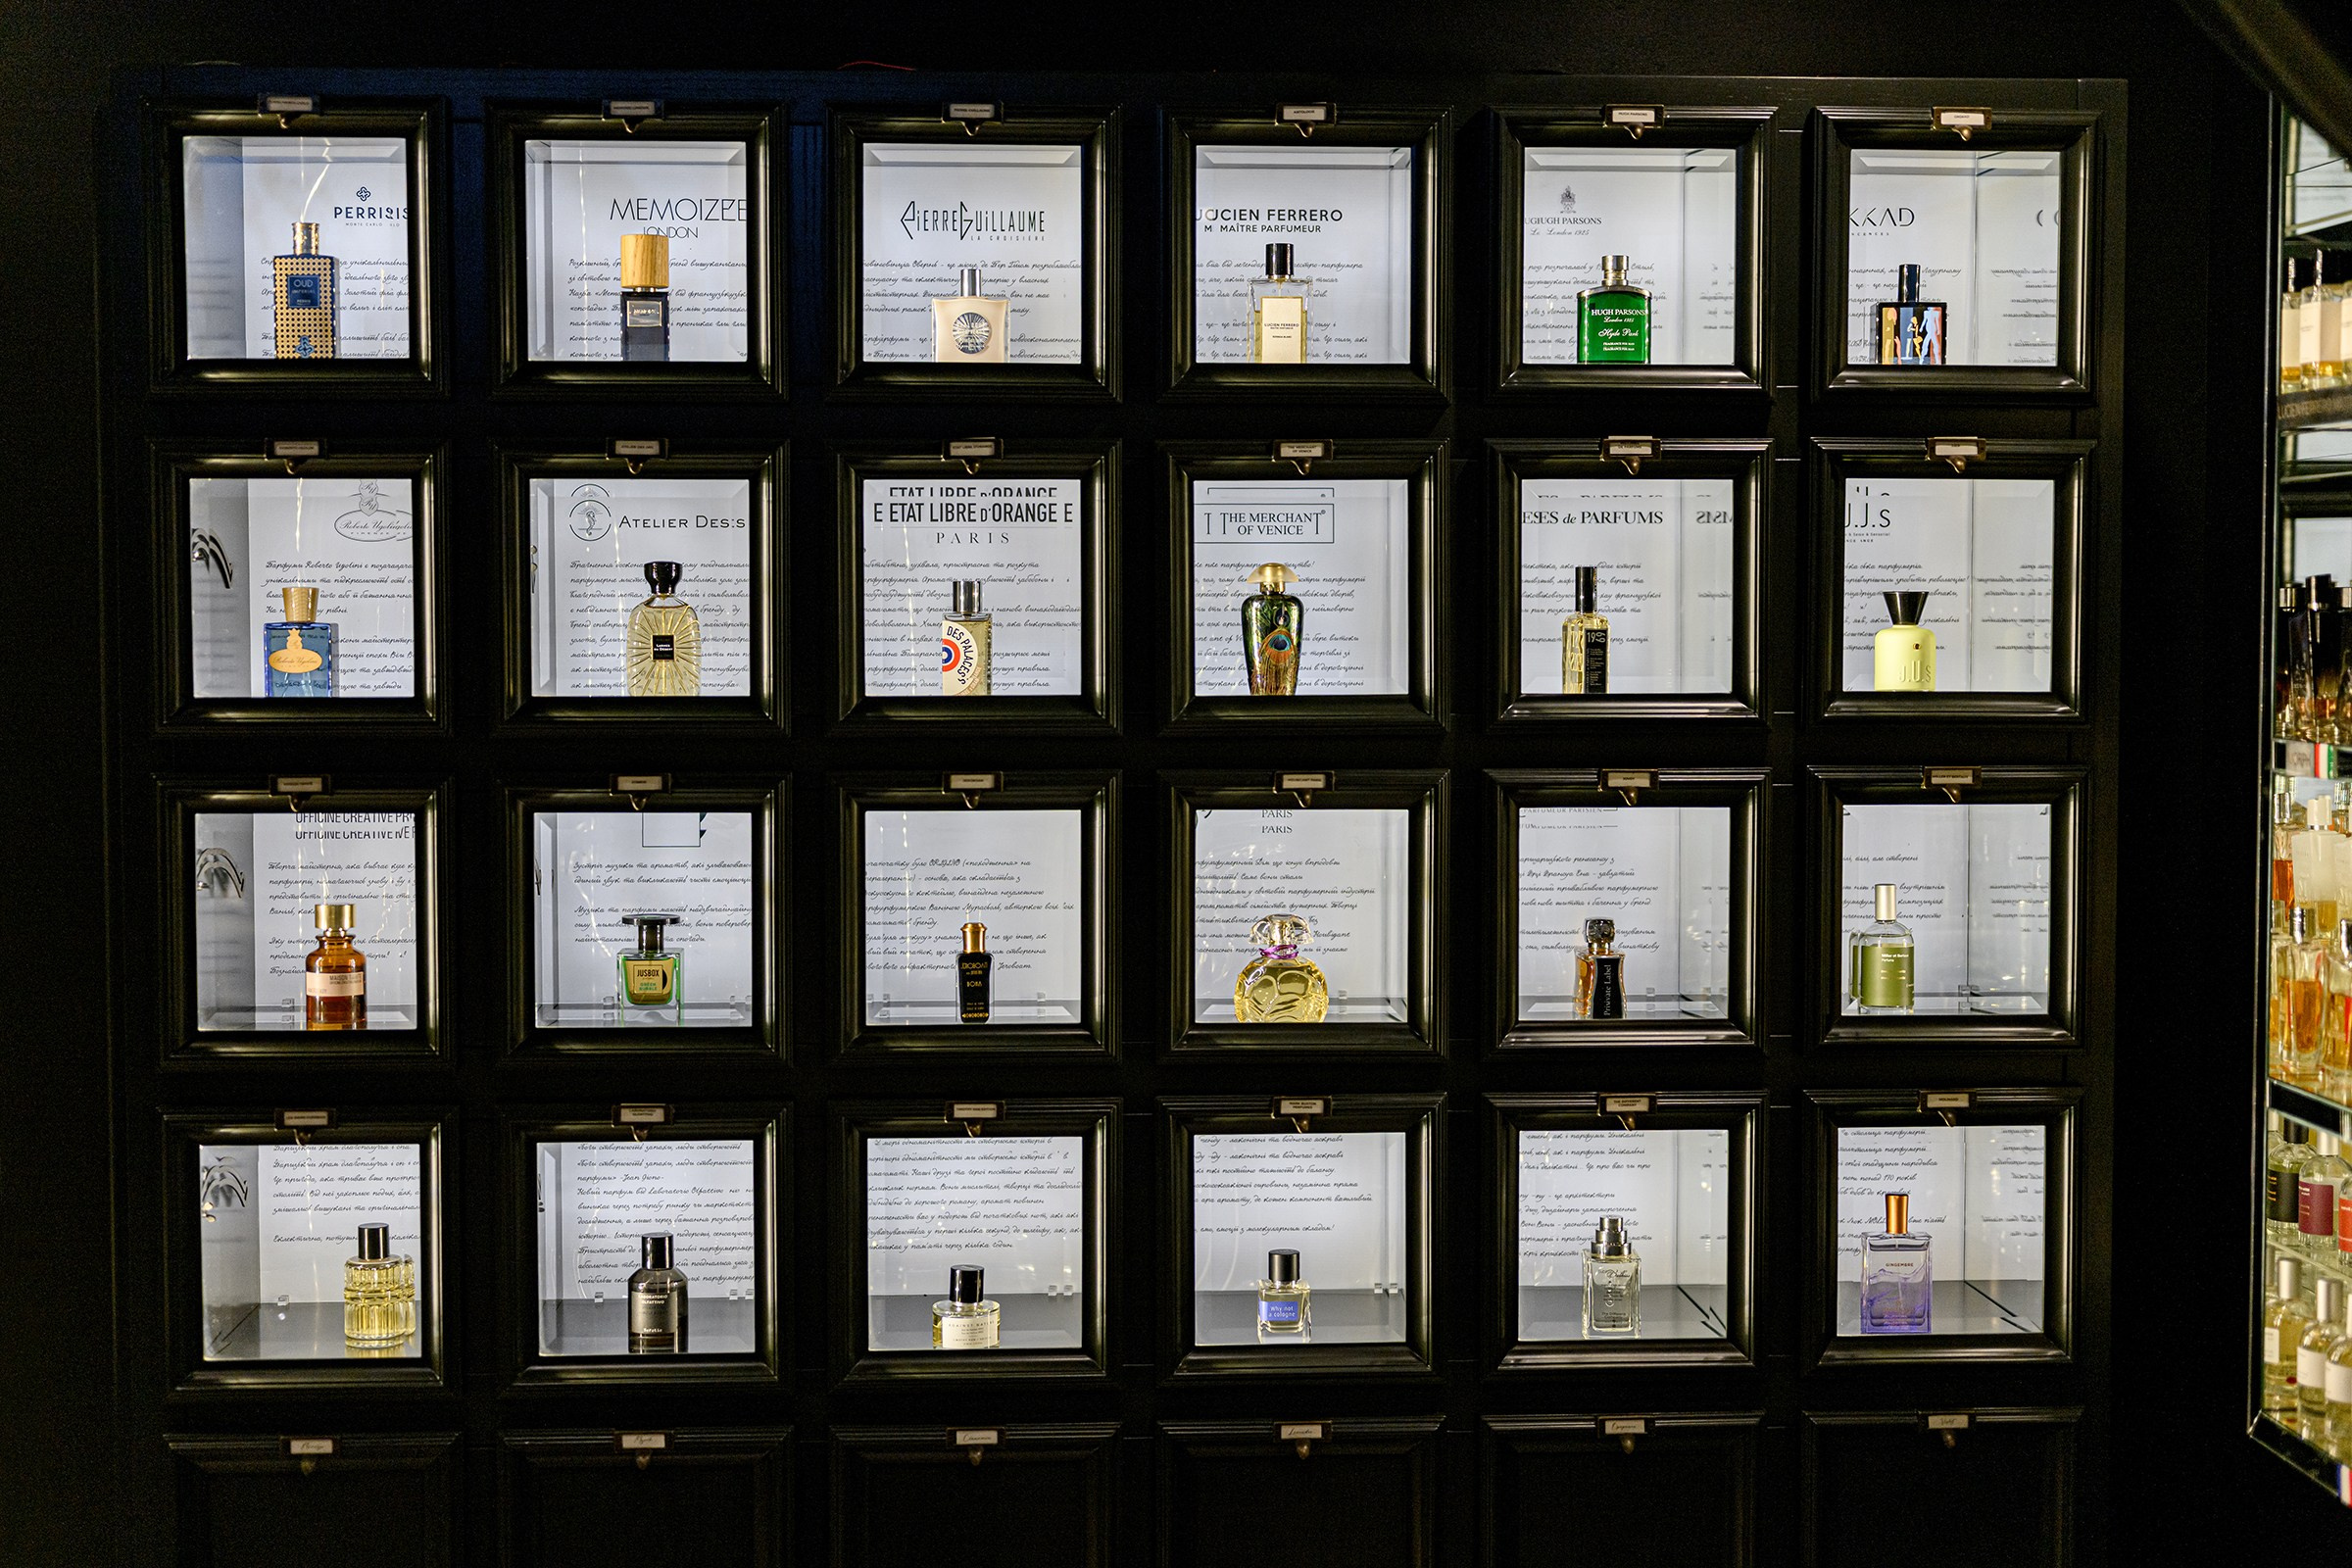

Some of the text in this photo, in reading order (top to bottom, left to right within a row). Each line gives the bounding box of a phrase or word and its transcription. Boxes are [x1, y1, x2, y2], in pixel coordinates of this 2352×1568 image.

[1266, 209, 1343, 222] FERRERO
[1220, 221, 1321, 234] MAÎTRE PARFUMEUR
[1598, 327, 1620, 338] Hyde
[889, 502, 925, 523] ETAT
[930, 502, 978, 523] LIBRE
[1562, 514, 1577, 523] de
[1580, 511, 1663, 524] PARFUMS
[1219, 512, 1249, 535] THE
[1248, 511, 1325, 535] MERCHANT
[1238, 524, 1303, 535] OF VENICE
[936, 532, 1008, 544] PARIS
[947, 625, 964, 640] DES
[1262, 809, 1293, 819] PARIS
[1262, 824, 1293, 835] PARIS
